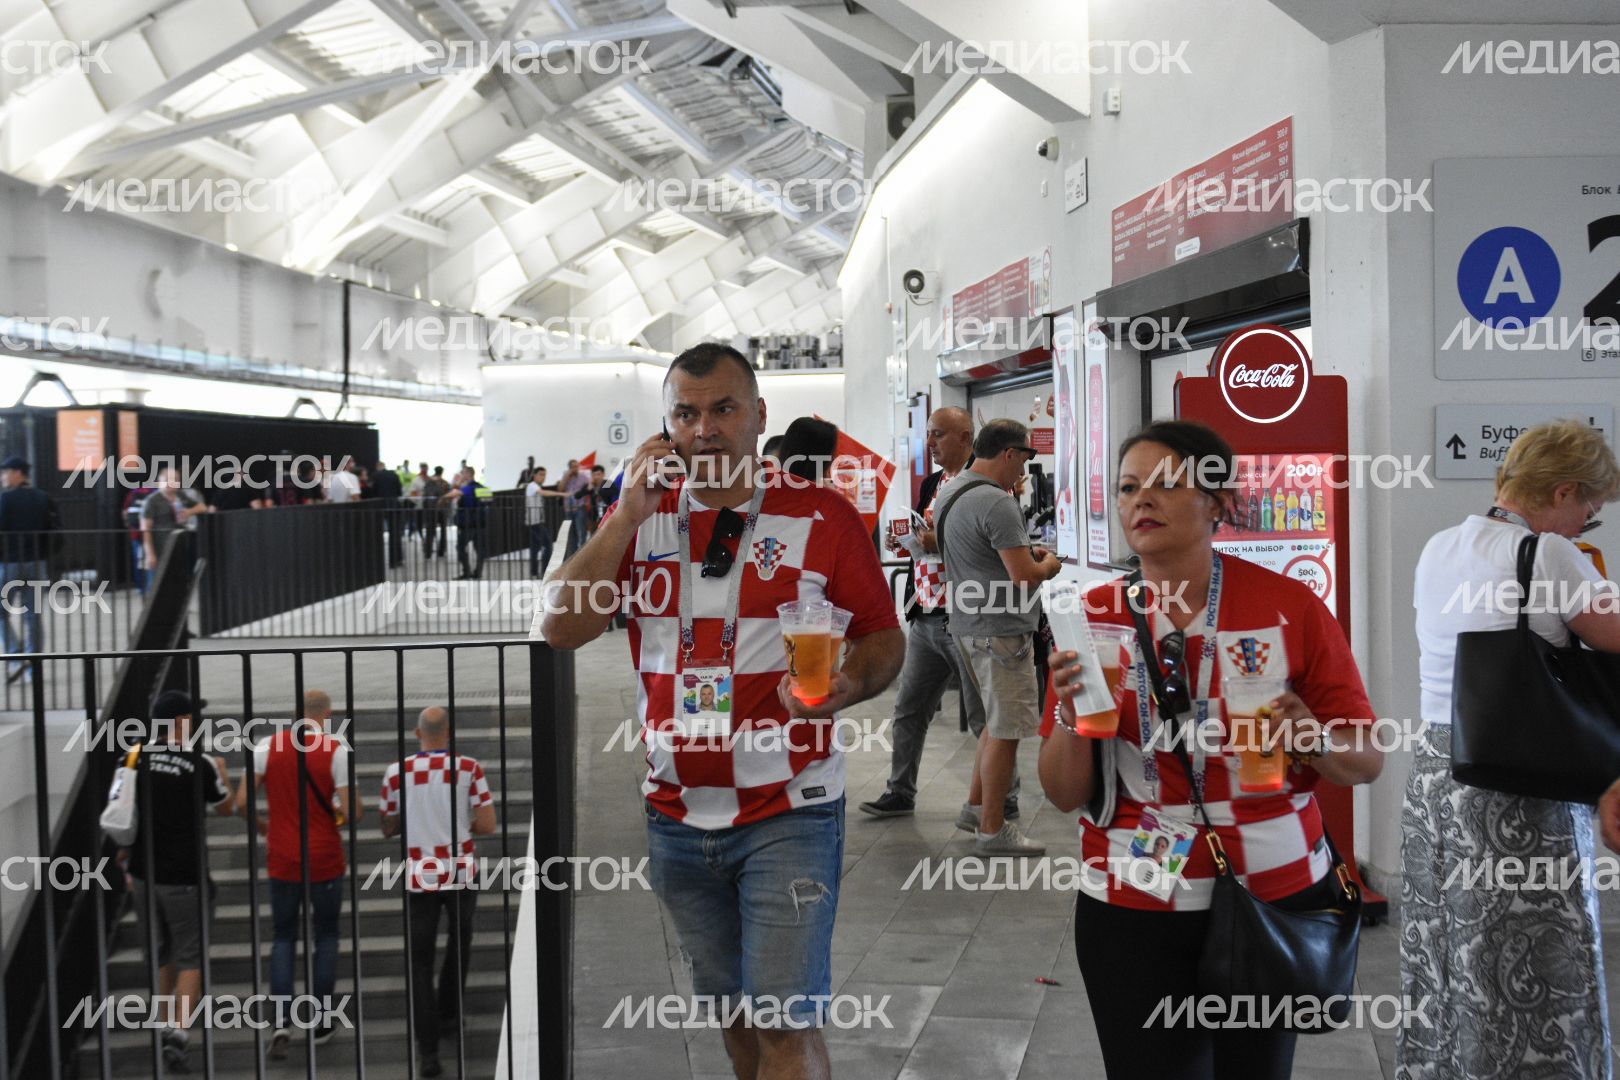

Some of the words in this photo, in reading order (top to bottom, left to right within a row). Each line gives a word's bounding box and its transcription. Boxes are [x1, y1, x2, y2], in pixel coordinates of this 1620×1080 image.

[1582, 185, 1612, 195] Блок
[1600, 350, 1620, 358] Эта
[614, 427, 624, 440] 6
[1479, 447, 1512, 462] Buff
[1206, 555, 1221, 628] РОСТОВ-НА-ДО
[1137, 662, 1153, 745] ROSTOV-ON-DON
